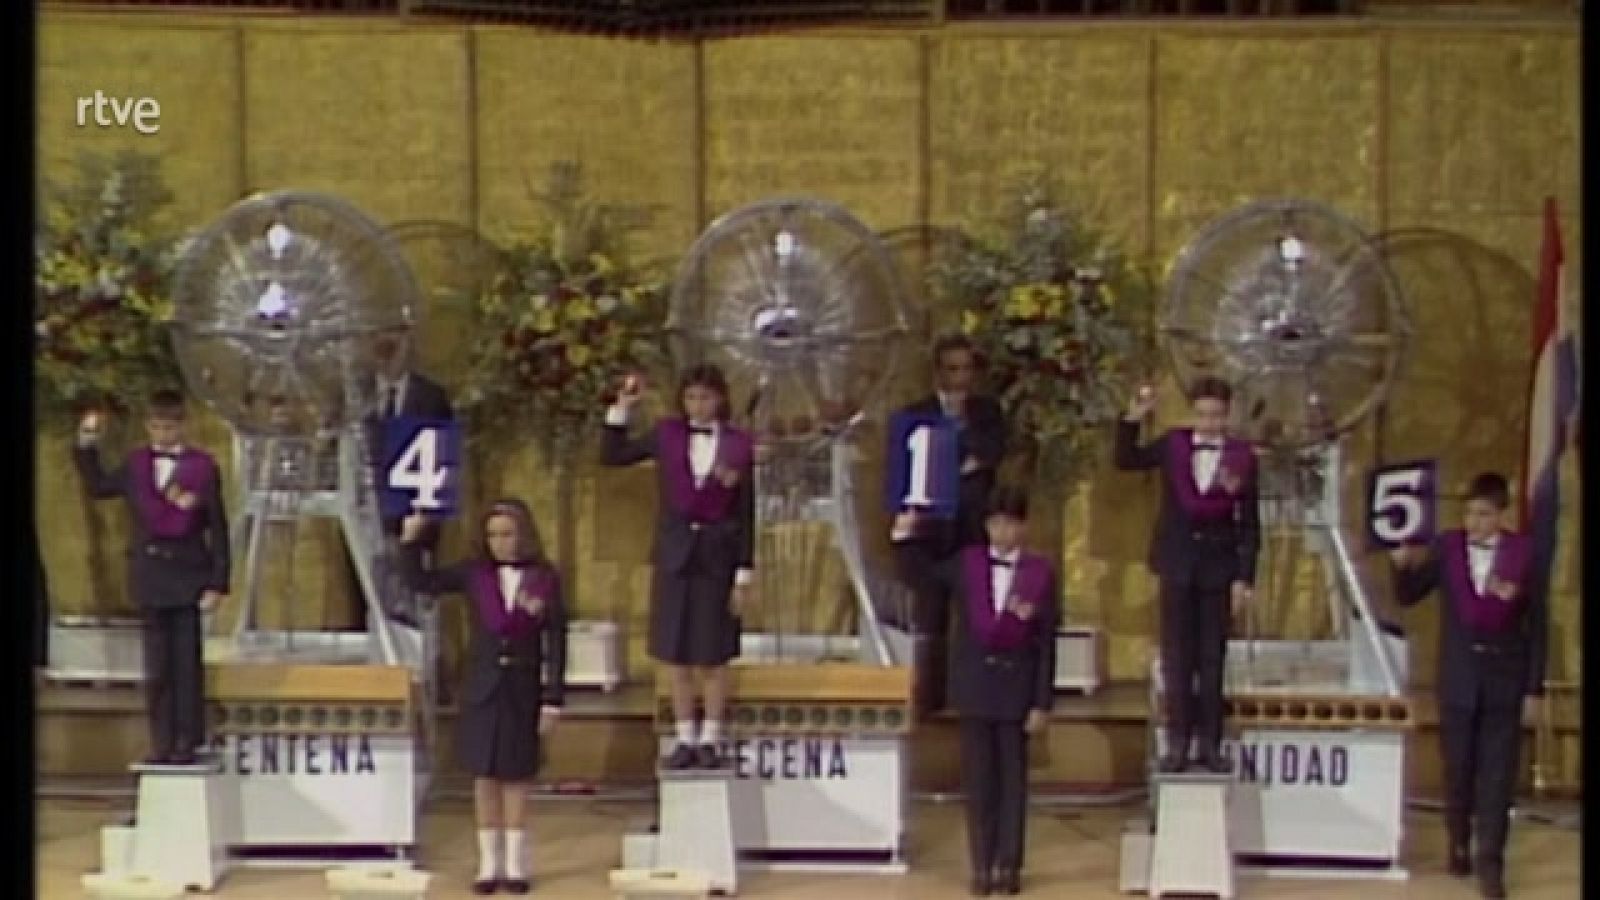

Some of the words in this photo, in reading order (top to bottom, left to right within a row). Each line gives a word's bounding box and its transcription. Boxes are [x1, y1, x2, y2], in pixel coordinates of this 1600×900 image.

[389, 427, 448, 508] 4
[902, 425, 934, 505] 1
[1373, 469, 1423, 541] 5
[722, 740, 846, 779] ECENA
